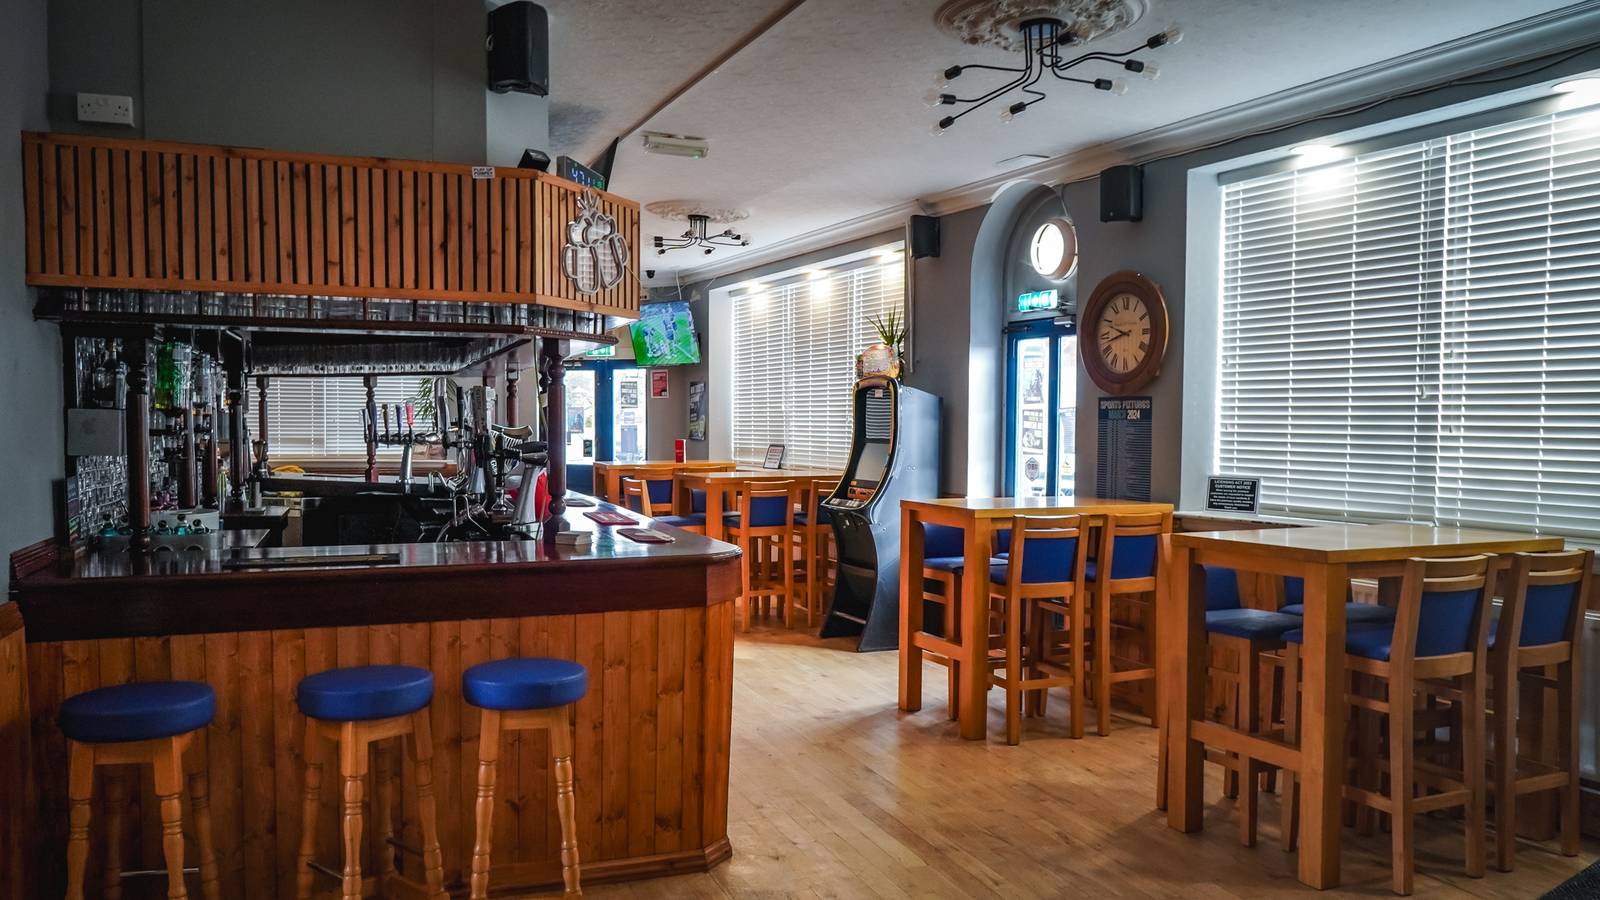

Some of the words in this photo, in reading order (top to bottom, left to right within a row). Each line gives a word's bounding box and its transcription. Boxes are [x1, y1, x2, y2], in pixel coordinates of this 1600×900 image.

[1100, 400, 1121, 409] SPORTS
[1122, 400, 1150, 409] FIXTURES
[1127, 409, 1140, 420] 2024
